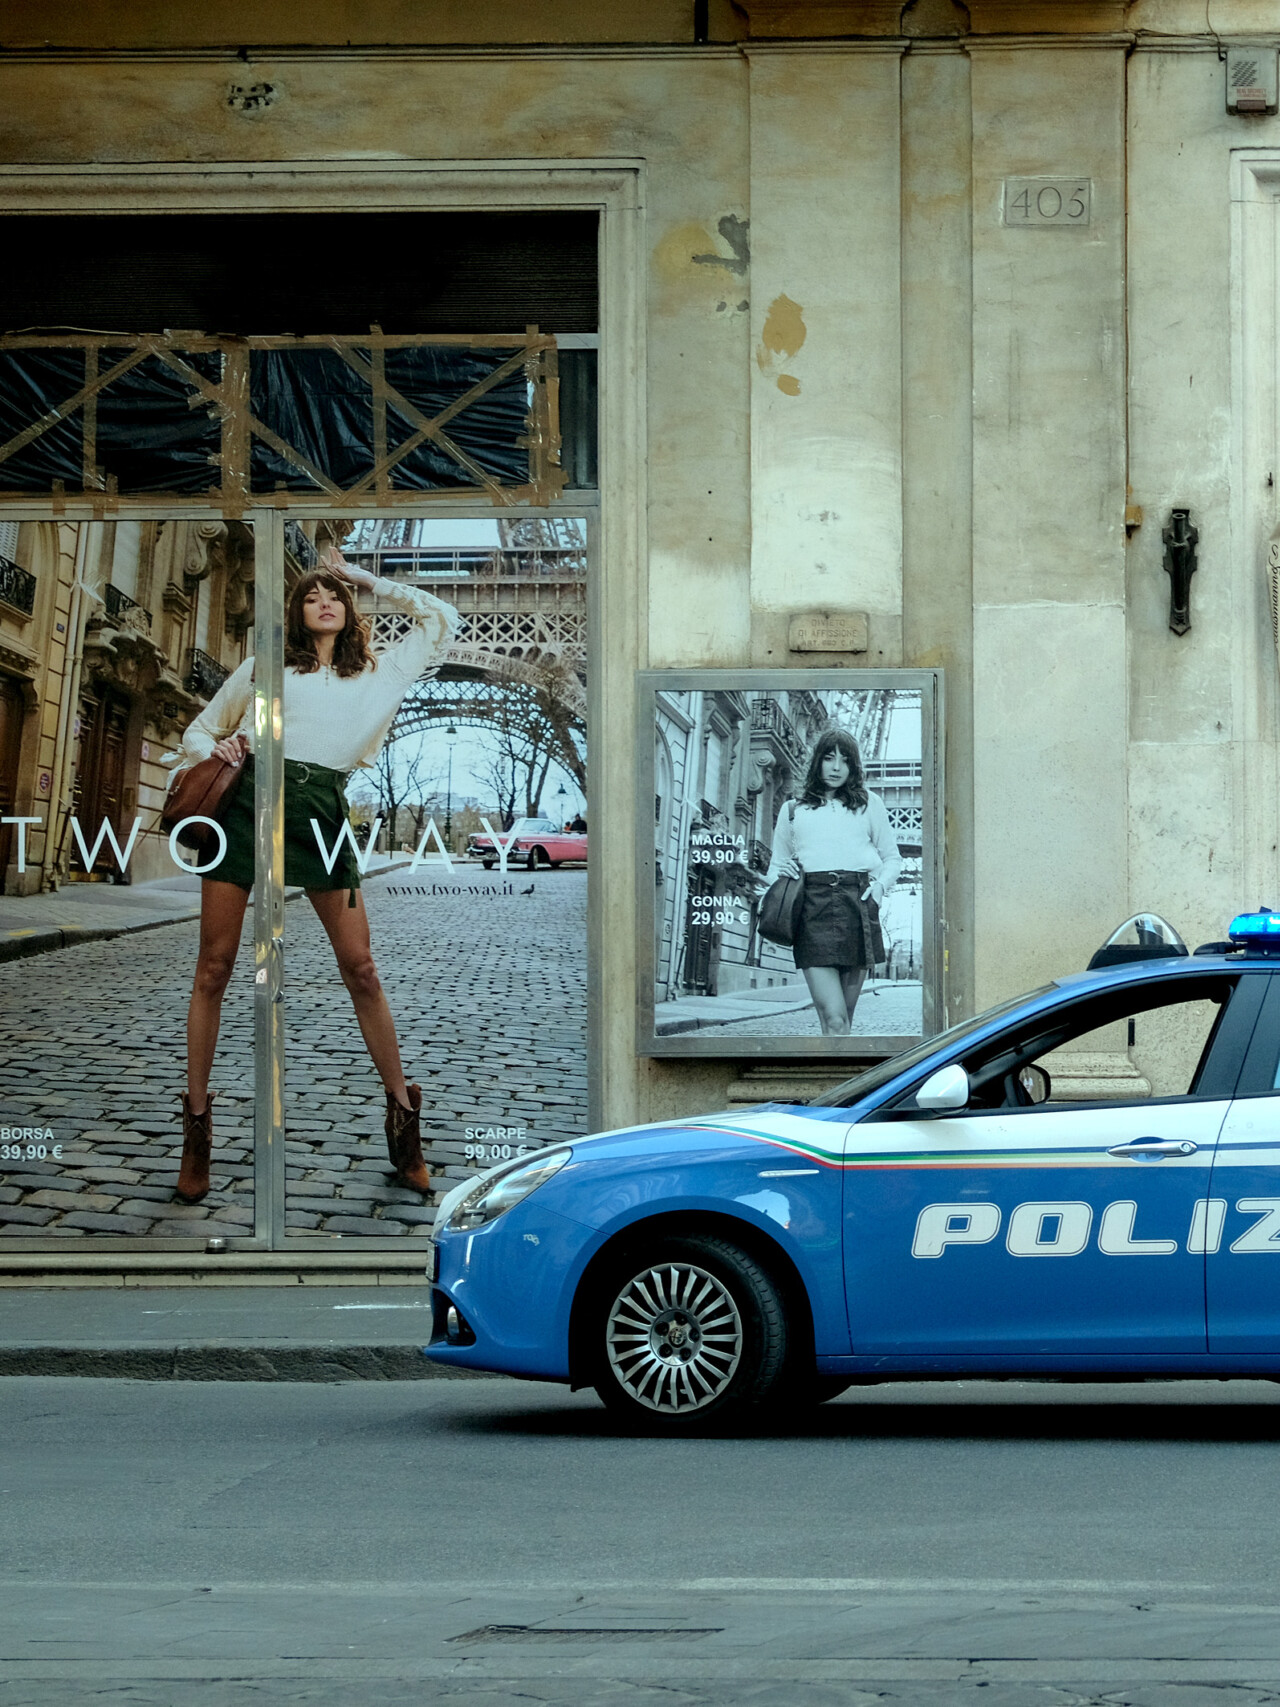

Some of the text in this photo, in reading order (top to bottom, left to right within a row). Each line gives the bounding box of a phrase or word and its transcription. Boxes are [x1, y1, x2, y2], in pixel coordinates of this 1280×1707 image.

[1011, 186, 1086, 219] 405
[1, 816, 526, 876] TWO WAY
[692, 834, 745, 845] MAGLIA
[692, 850, 749, 865] 39,90 €
[386, 881, 514, 896] www.two-way.it
[692, 895, 742, 907] GONNA
[691, 911, 749, 927] 29,90 €
[1, 1127, 54, 1139] BORSA
[464, 1127, 527, 1139] SCARPE
[1, 1144, 63, 1162] 39,90 €
[464, 1144, 527, 1161] 99,00 €
